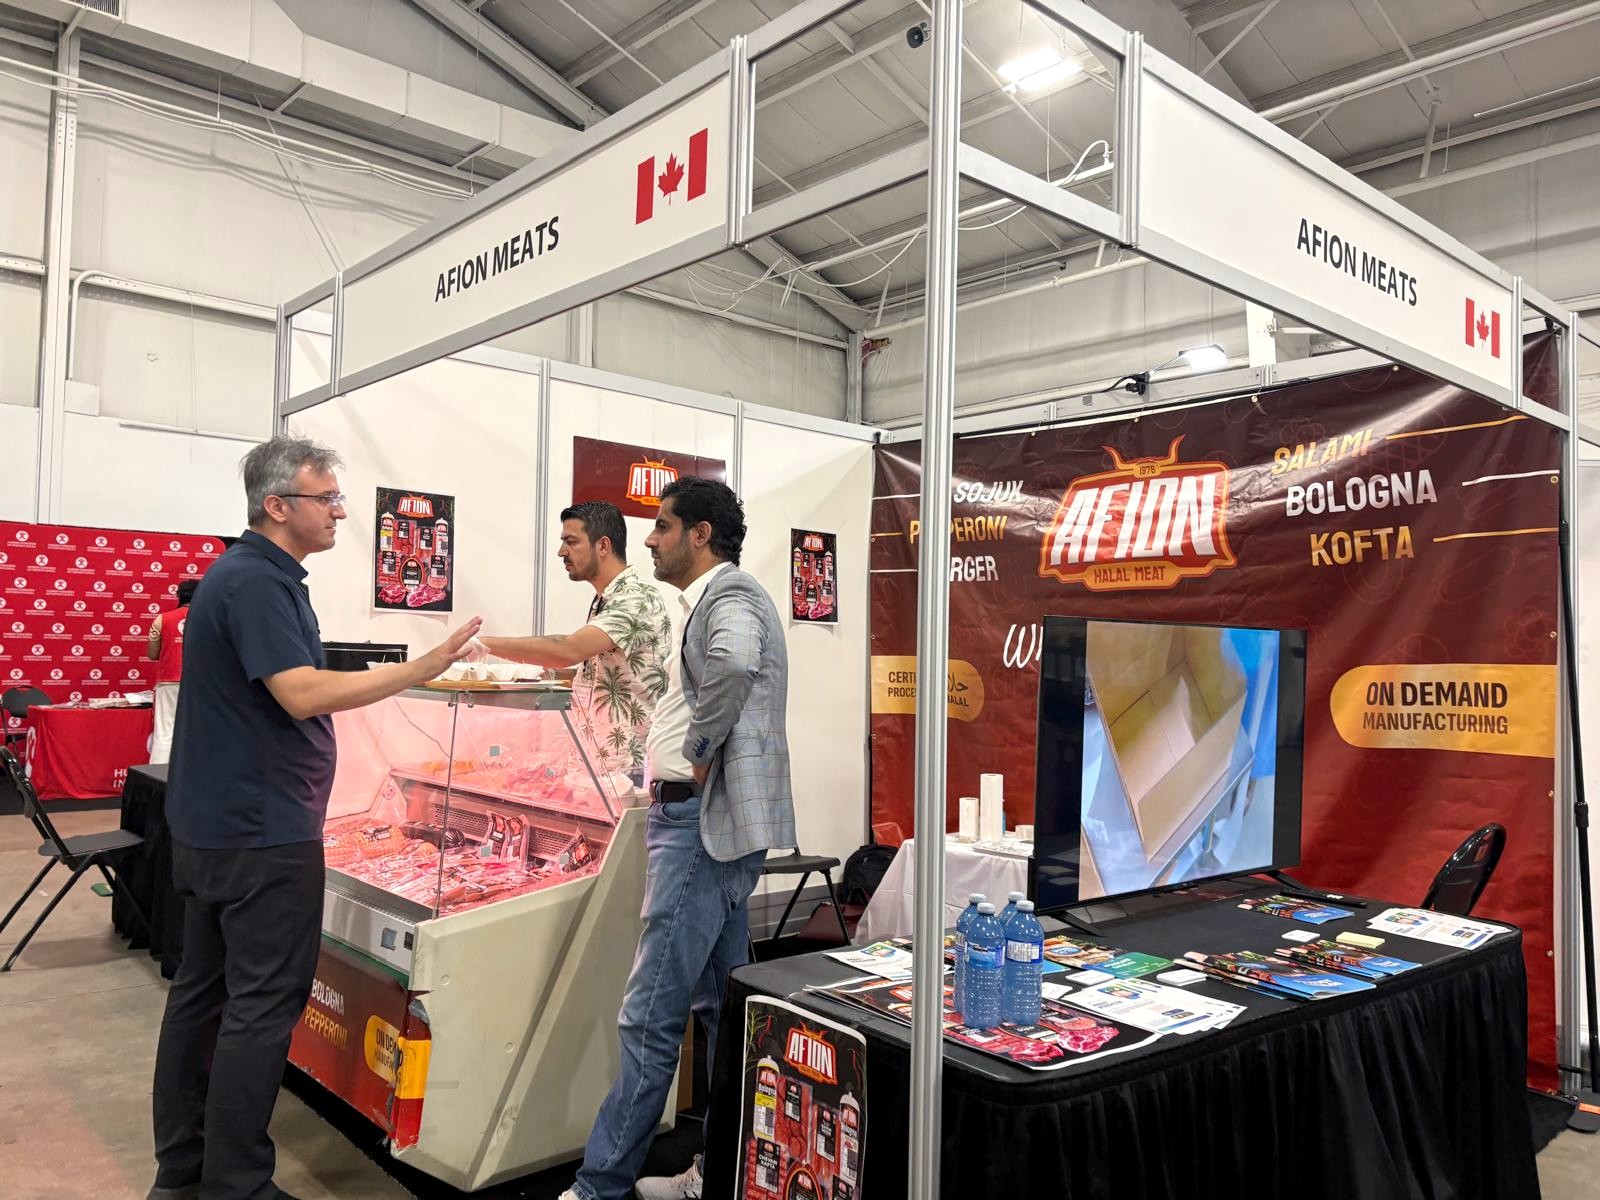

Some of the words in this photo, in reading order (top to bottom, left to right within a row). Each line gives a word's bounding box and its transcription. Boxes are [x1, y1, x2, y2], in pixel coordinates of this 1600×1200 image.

[435, 252, 488, 302] AFION
[492, 216, 559, 276] MEATS
[1297, 218, 1356, 277] AFION
[1362, 251, 1417, 306] MEATS
[1271, 428, 1373, 476] SALAMI
[401, 499, 432, 514] AFION
[953, 480, 1024, 504] SOJUK
[1286, 469, 1438, 517] BOLOGNA
[910, 515, 1008, 545] PERONI
[1050, 475, 1217, 566] AFION
[1310, 526, 1415, 567] KOFTA
[949, 555, 999, 582] RGER
[1094, 567, 1130, 584] HALAL
[1134, 565, 1166, 581] MEAT
[888, 671, 917, 683] CERTI
[1365, 681, 1394, 706] ON
[1401, 681, 1508, 708] DEMAND
[1362, 712, 1509, 735] MANUFACTURING
[311, 977, 344, 1016] BOLOGNA
[304, 1005, 348, 1049] PEPPERONI
[376, 1028, 385, 1048] ON
[788, 1032, 833, 1078] AFION
